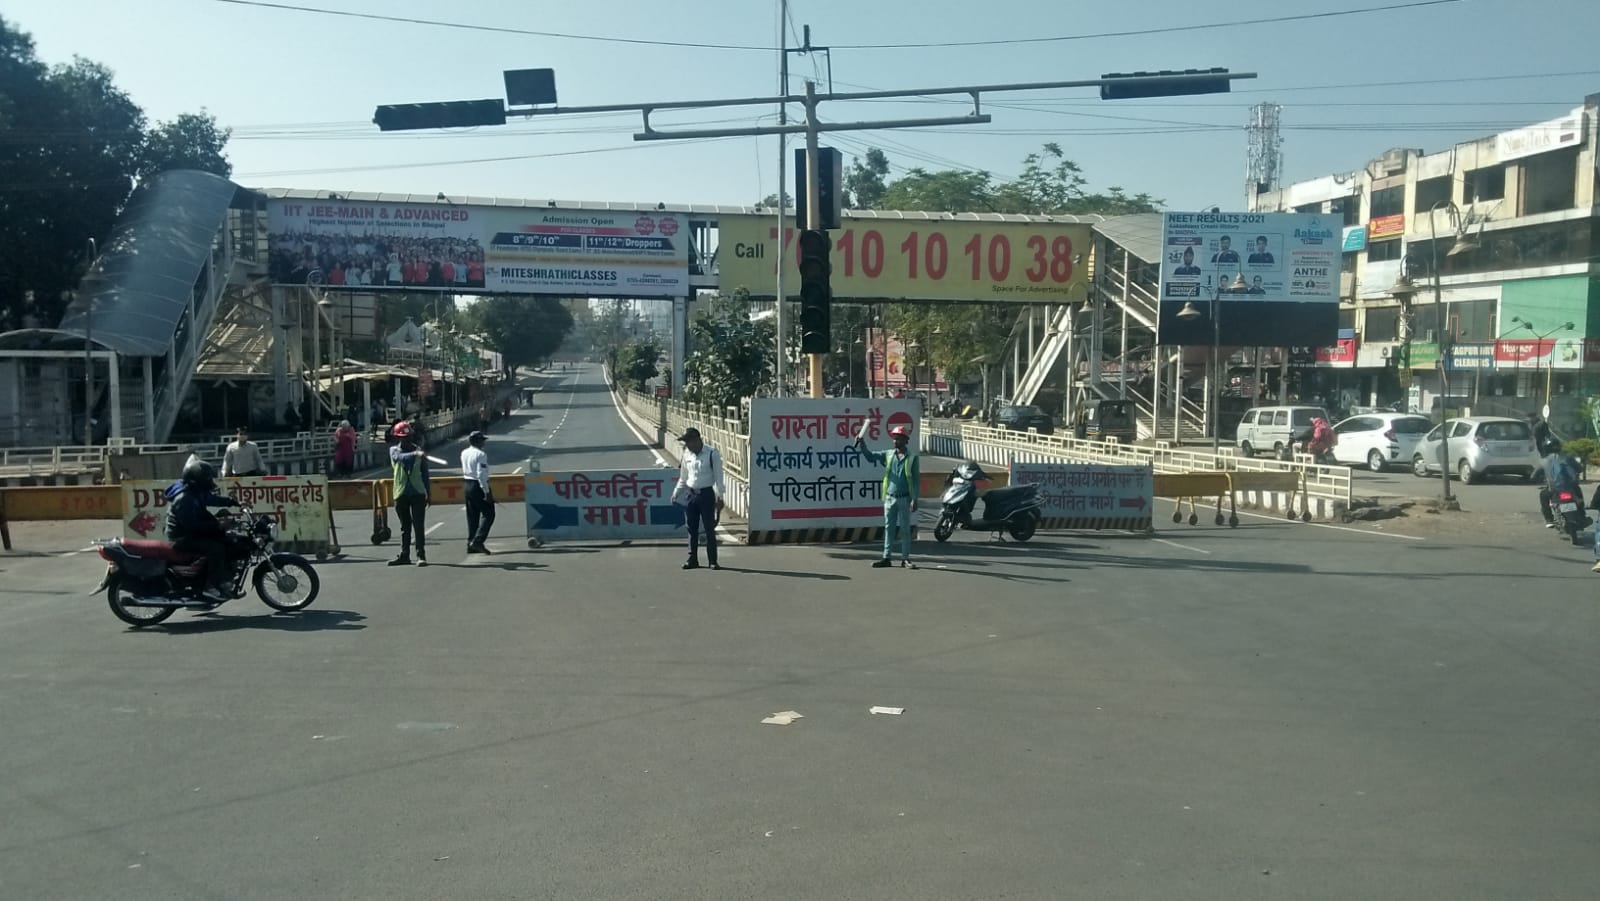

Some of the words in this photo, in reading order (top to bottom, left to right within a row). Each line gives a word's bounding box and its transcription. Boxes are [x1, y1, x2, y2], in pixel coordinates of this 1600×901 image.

[284, 205, 302, 217] IIT
[307, 206, 375, 219] JEE-MAIN
[379, 208, 389, 219] &
[394, 208, 470, 222] ADVANCED
[542, 215, 589, 224] Admission
[591, 217, 615, 226] Open
[1168, 213, 1194, 223] NEET
[1197, 213, 1240, 224] RESULTS
[1242, 214, 1265, 224] 2021
[734, 242, 764, 259] Call
[836, 228, 885, 279] 10
[901, 230, 948, 281] 10
[965, 233, 1012, 283] 10
[1025, 234, 1073, 284] 38
[1294, 267, 1329, 276] ANTHE
[771, 414, 829, 440] रास्ता
[832, 407, 868, 439] बंद
[868, 406, 884, 441] है
[755, 446, 782, 472] मेट्रो
[783, 446, 813, 470] कार्य
[816, 444, 863, 470] प्रगति
[301, 480, 324, 503] रोड
[552, 472, 665, 499] परिवर्तित
[769, 476, 856, 503] परिवर्तित
[582, 498, 648, 526] मार्ग
